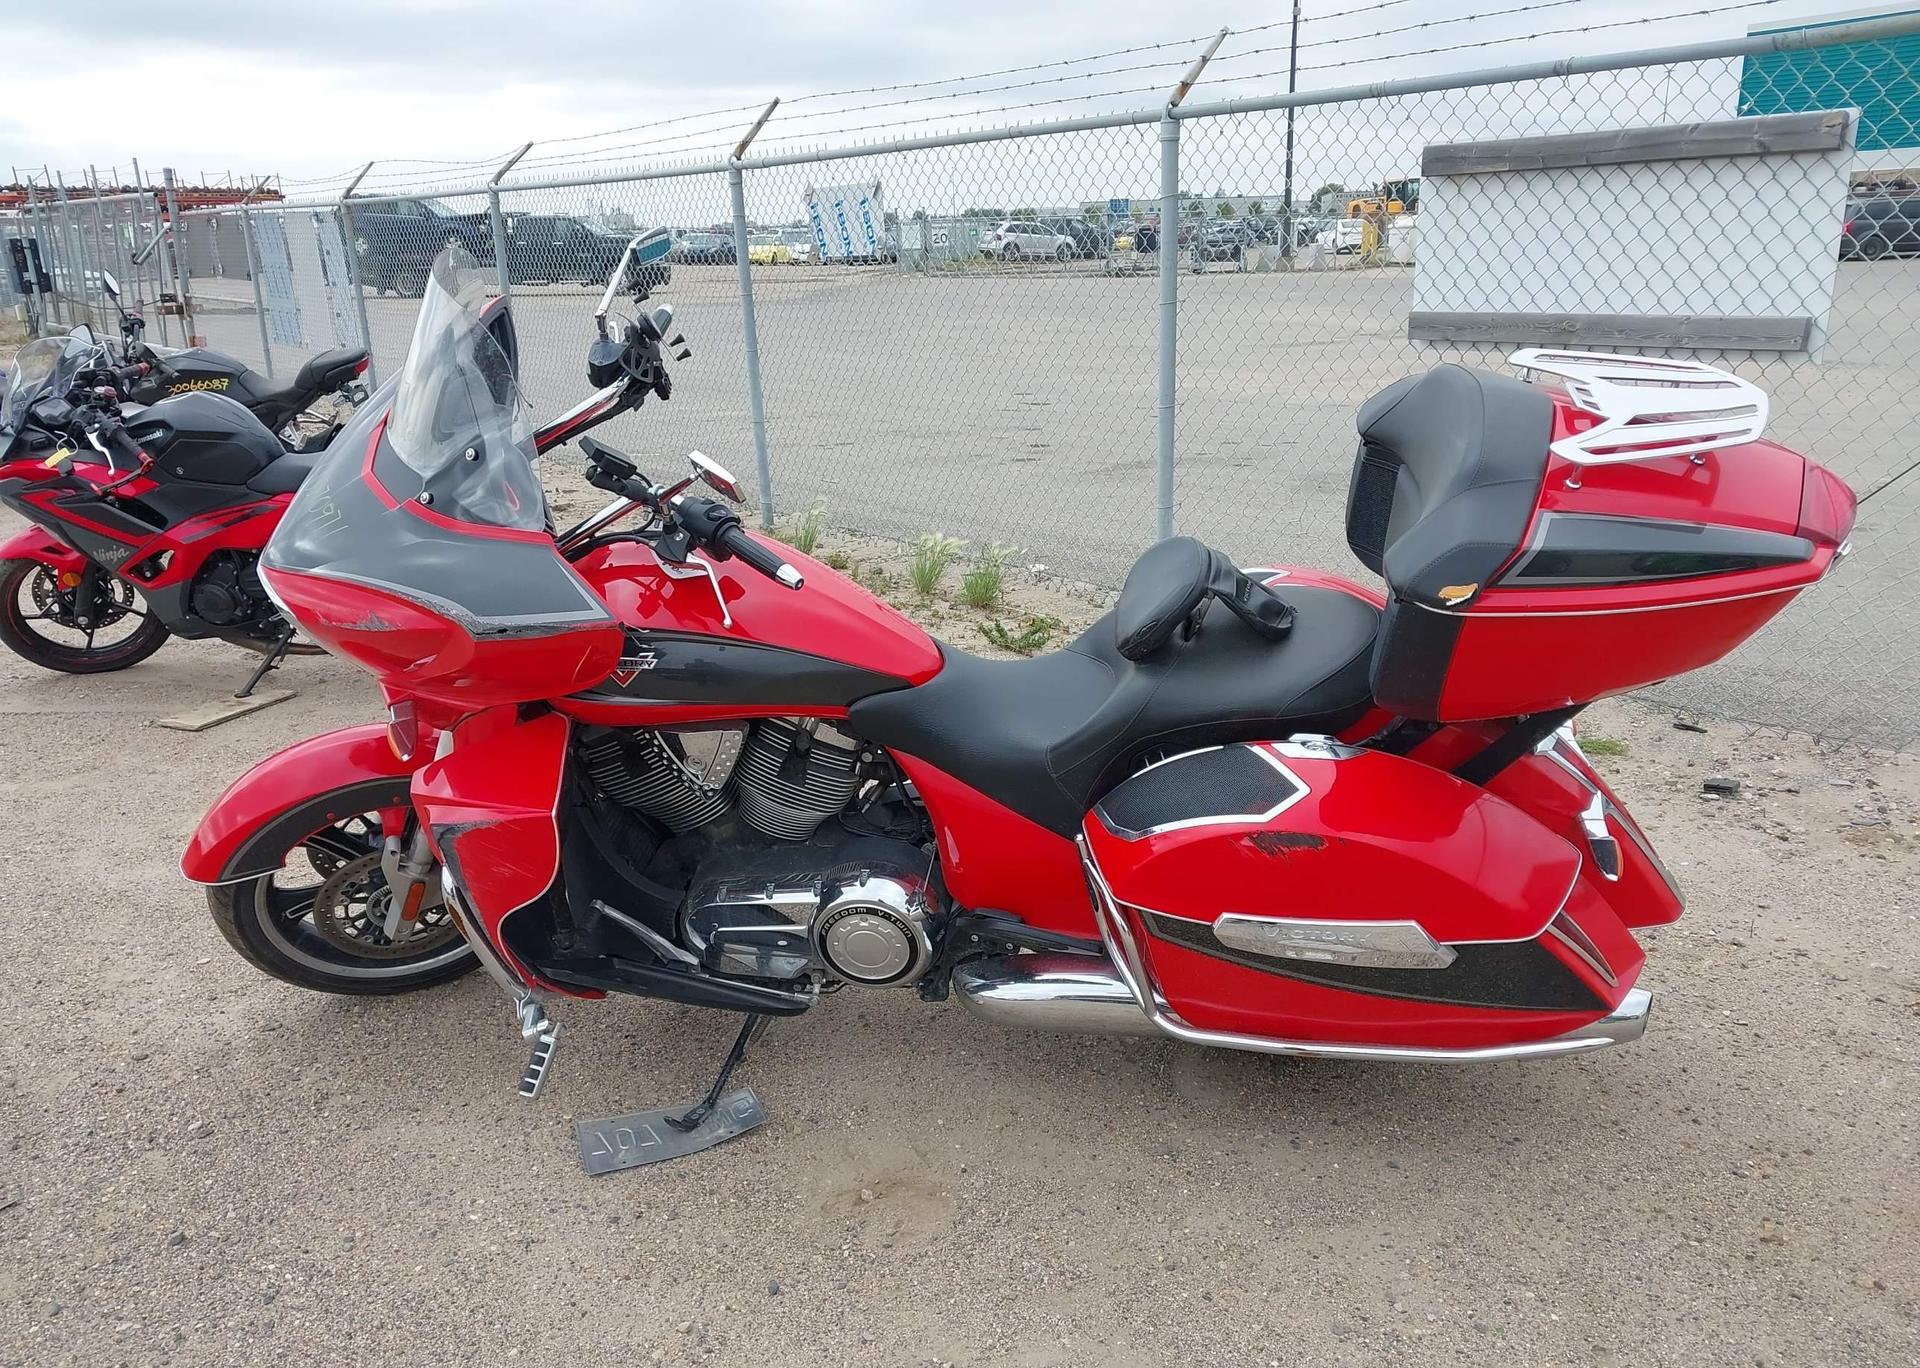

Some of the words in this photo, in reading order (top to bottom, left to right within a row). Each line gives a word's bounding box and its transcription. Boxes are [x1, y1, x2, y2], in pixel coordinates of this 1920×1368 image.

[932, 233, 948, 244] 20
[93, 545, 130, 562] Ninja
[821, 907, 867, 937] FREEDOM
[877, 910, 913, 938] V-TWIN
[1260, 923, 1372, 942] VICTORY
